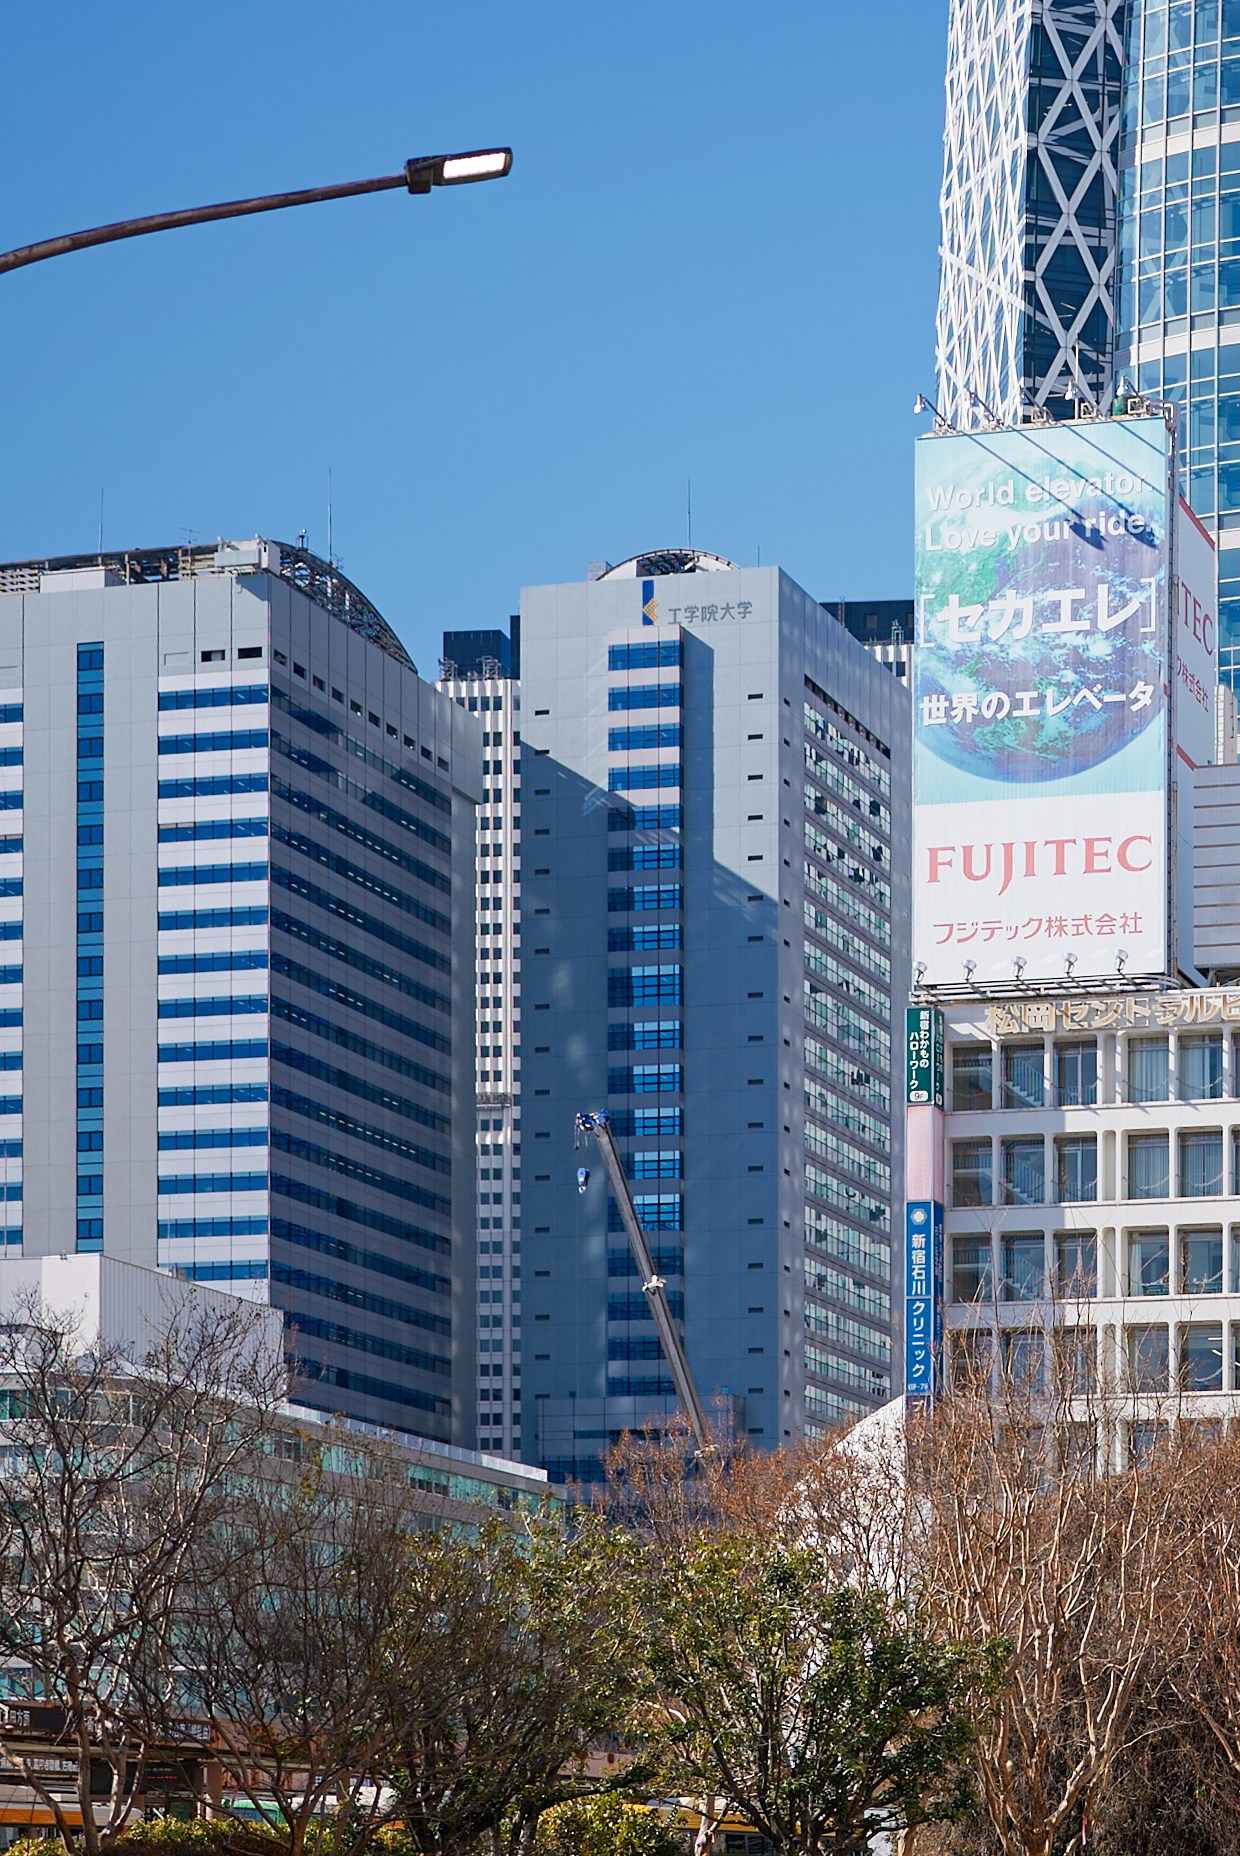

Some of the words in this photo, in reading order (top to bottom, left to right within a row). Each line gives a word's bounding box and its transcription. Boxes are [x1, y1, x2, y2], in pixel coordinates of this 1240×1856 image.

[926, 479, 1015, 511] World
[1026, 472, 1155, 503] elevator.
[925, 527, 997, 551] Love
[1007, 519, 1071, 551] your
[1085, 510, 1152, 538] ride.
[668, 601, 753, 625] 工学院大学
[919, 681, 1155, 726] 世界のエレベータ
[926, 835, 1153, 896] FUJITEC
[933, 912, 1143, 944] フジテック株式会社
[909, 1031, 919, 1089] ハローワーク
